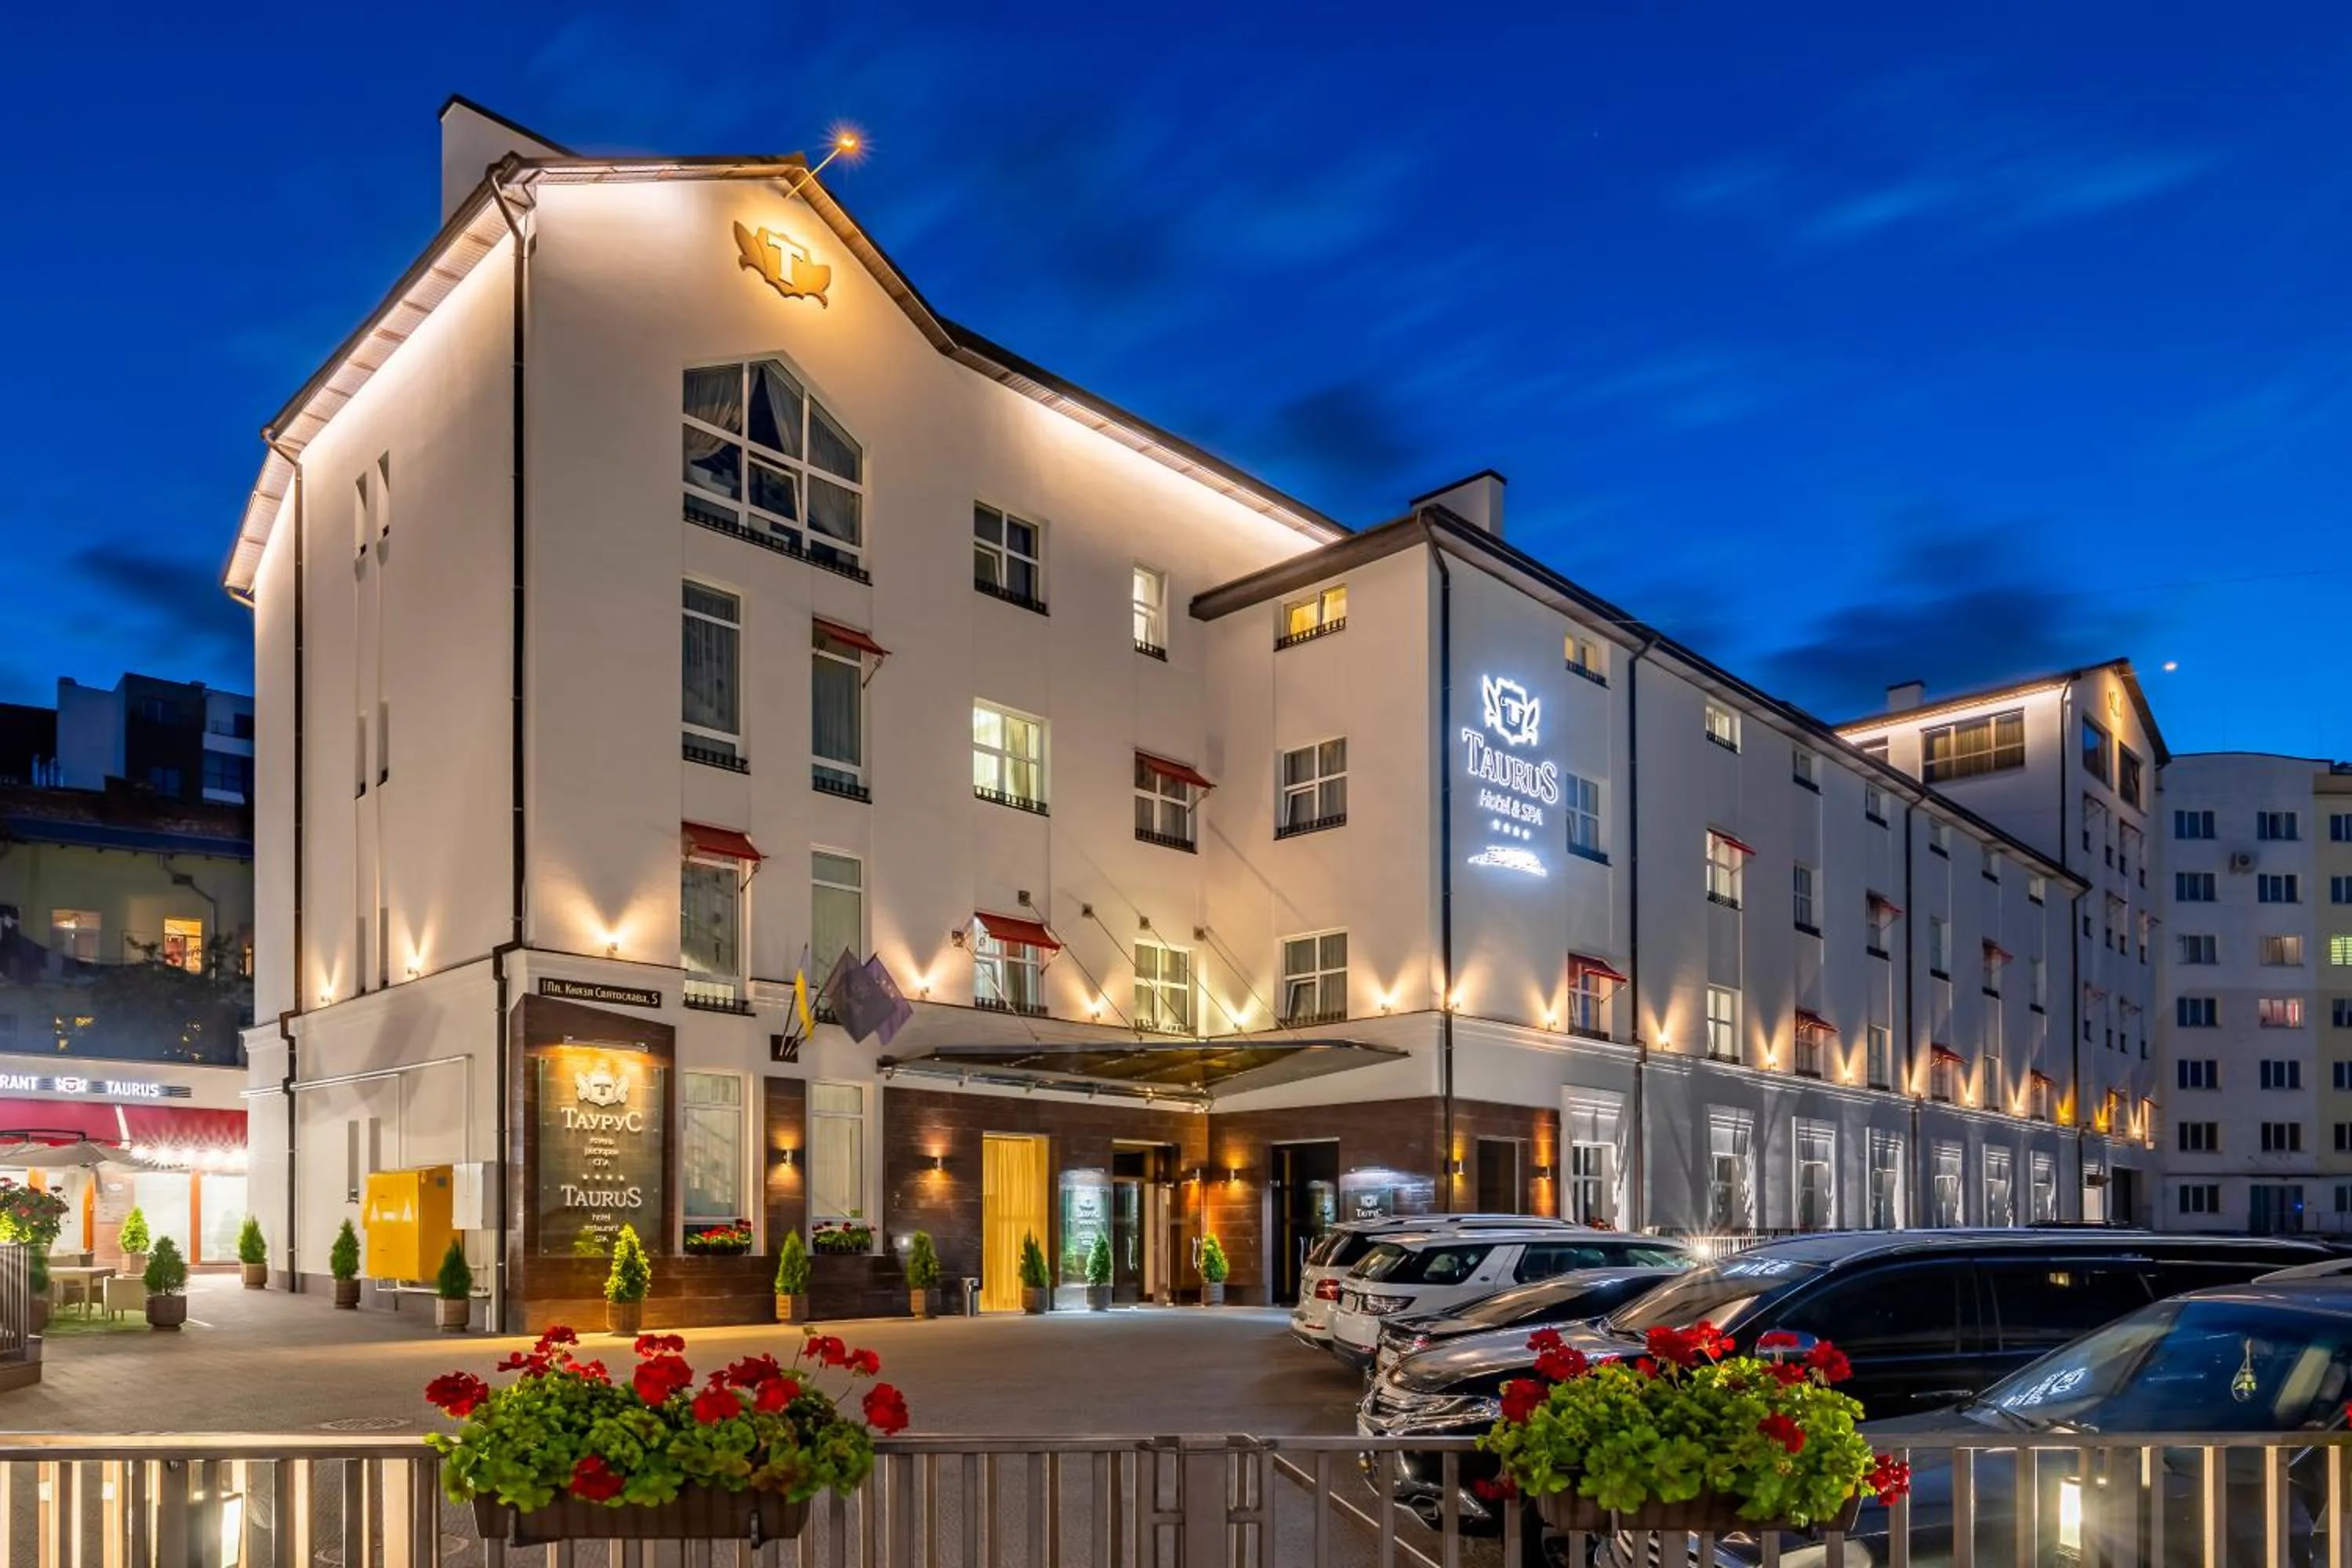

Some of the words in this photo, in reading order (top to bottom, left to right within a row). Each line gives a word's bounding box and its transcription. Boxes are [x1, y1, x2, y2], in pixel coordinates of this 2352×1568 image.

[1461, 728, 1558, 804] TAURUS
[1520, 803, 1544, 826] SPA
[564, 982, 594, 996] Князя
[652, 993, 659, 1004] 5
[105, 1080, 160, 1098] TAURUS
[561, 1185, 643, 1208] TAURUS
